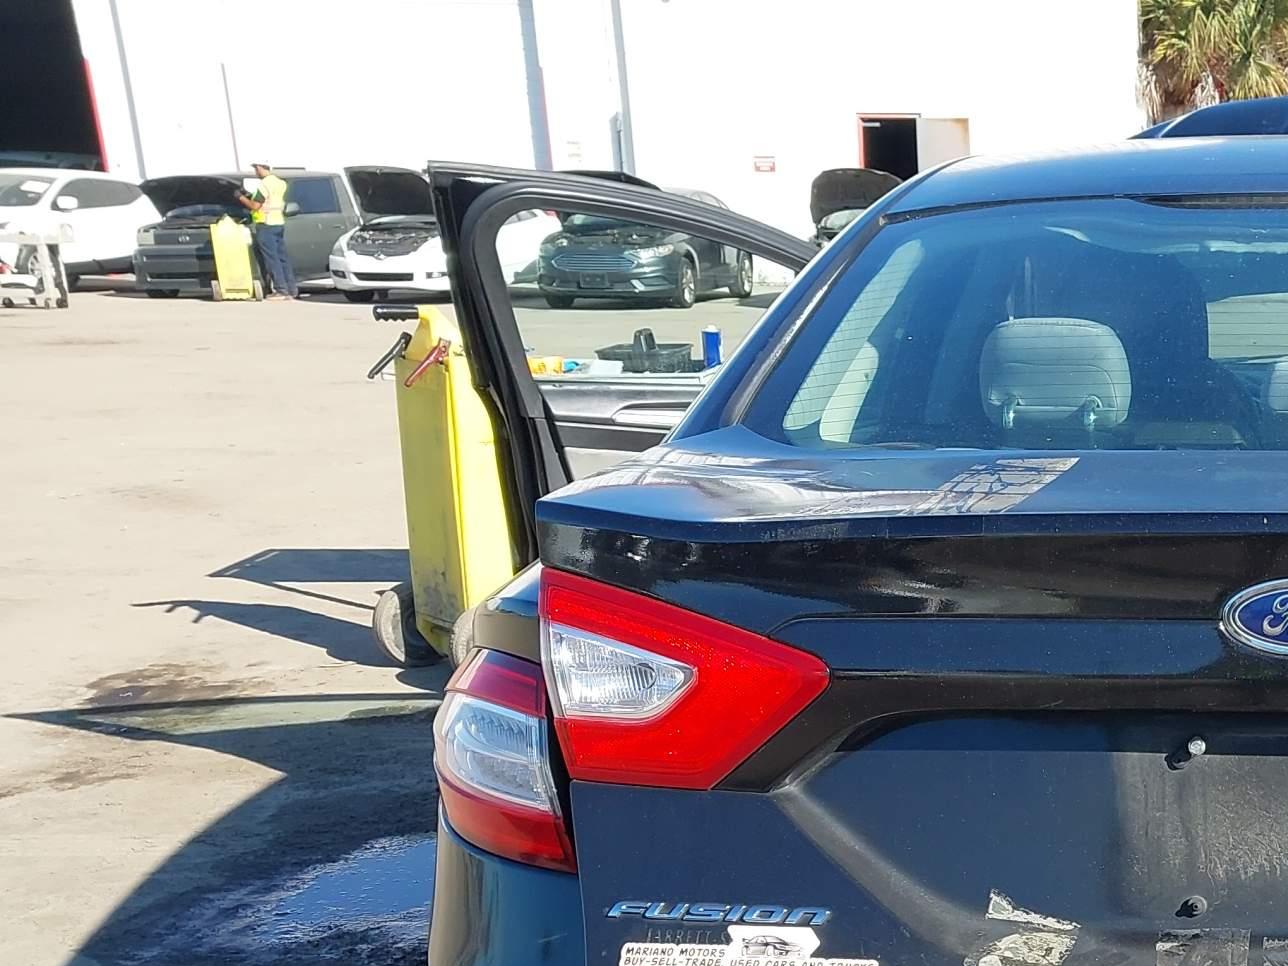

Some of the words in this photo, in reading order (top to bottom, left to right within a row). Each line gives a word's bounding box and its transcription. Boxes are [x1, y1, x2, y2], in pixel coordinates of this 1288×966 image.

[606, 901, 830, 925] FUSION
[625, 947, 674, 956] MARIANO
[679, 948, 726, 957] MOTORS
